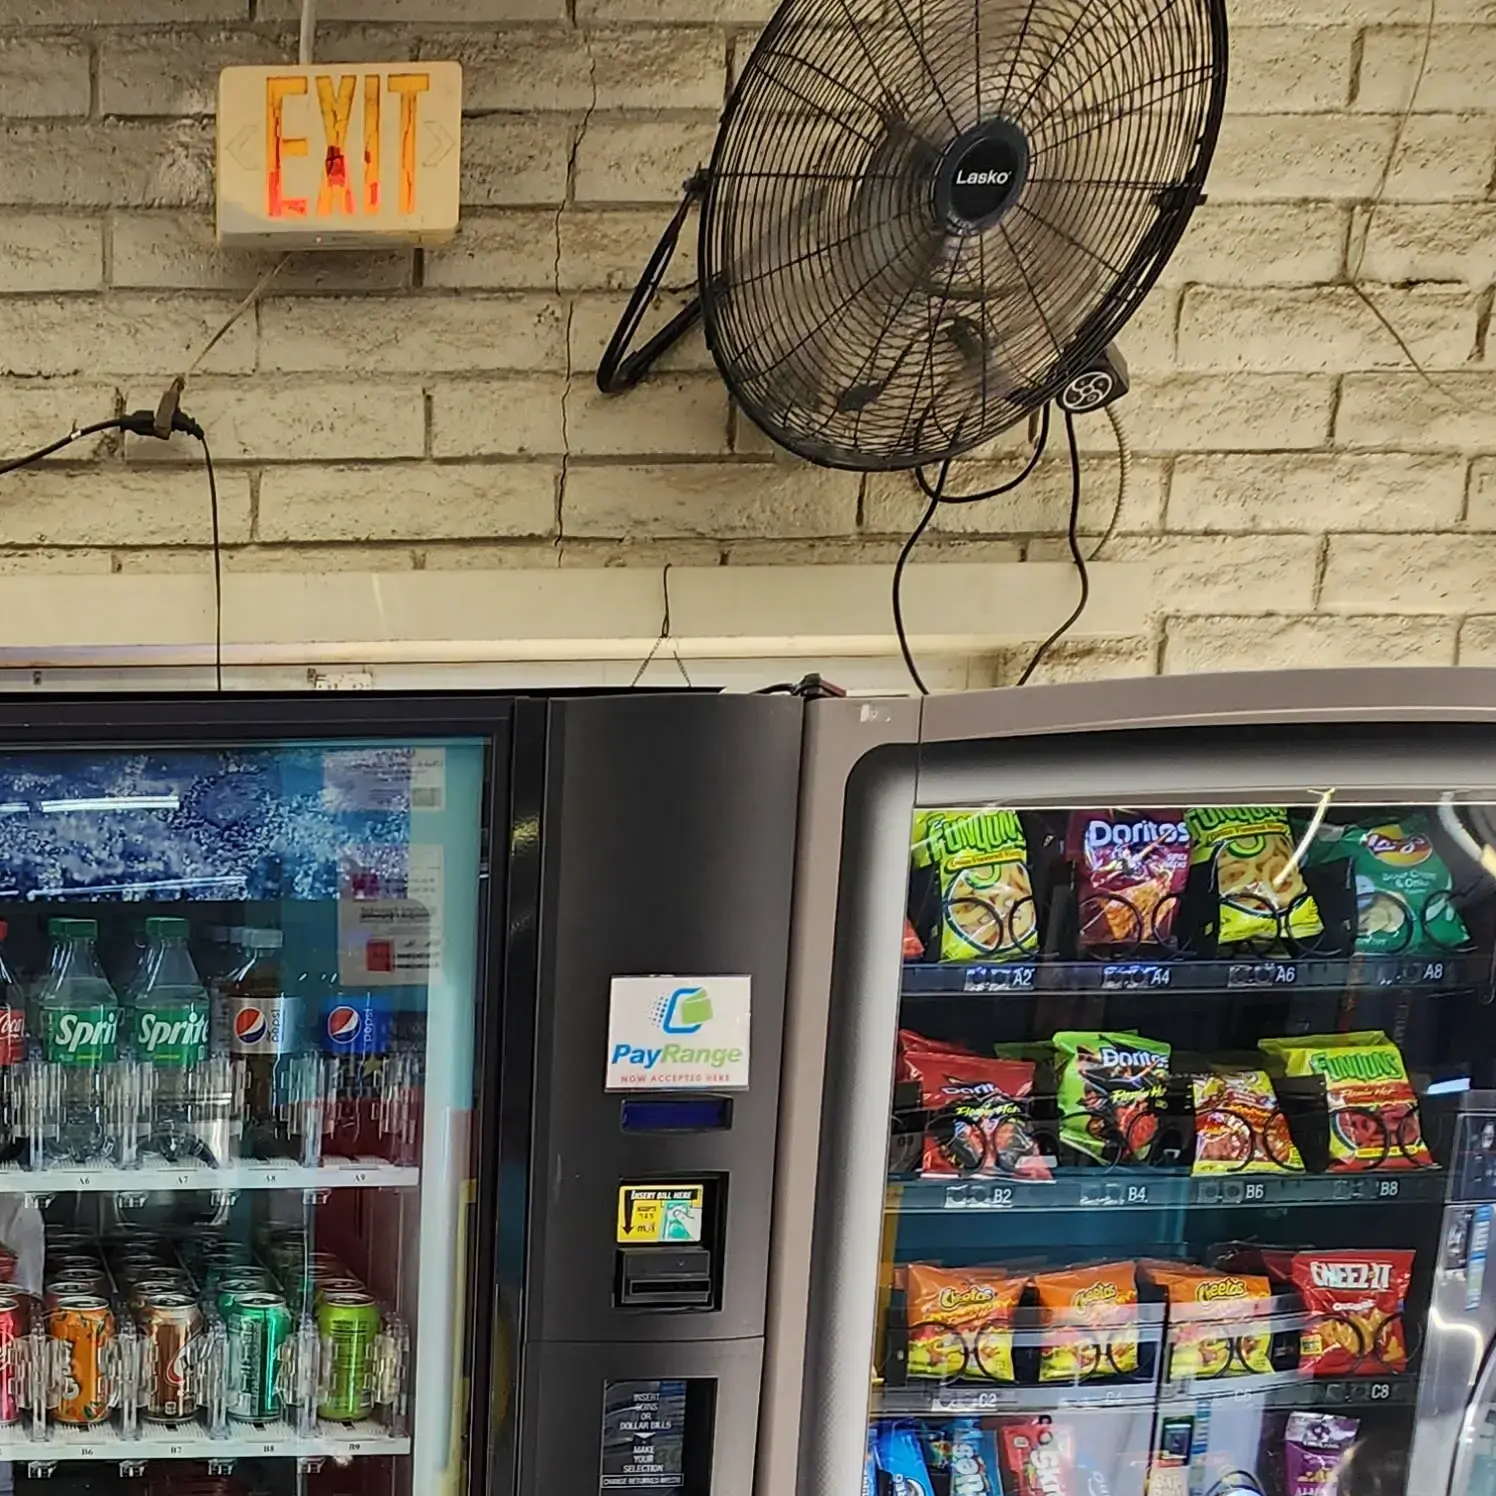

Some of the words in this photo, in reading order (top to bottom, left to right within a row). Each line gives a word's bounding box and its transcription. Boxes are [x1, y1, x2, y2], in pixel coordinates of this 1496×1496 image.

[266, 73, 429, 216] EXIT
[956, 170, 1011, 185] Lasko
[1088, 819, 1191, 846] Doritos
[1015, 970, 1032, 986] A2
[1153, 970, 1170, 984] A4
[1276, 967, 1295, 982] A6
[1424, 964, 1443, 979] A8
[270, 1008, 281, 1042] pepsi
[612, 1044, 742, 1068] PayRange
[1102, 1049, 1168, 1069] Doritos
[78, 1177, 90, 1185] A6
[176, 1176, 188, 1184] A7
[264, 1174, 276, 1182] A8
[353, 1173, 366, 1182] A9
[994, 1188, 1012, 1203] B2
[1128, 1186, 1147, 1201] B4
[1245, 1184, 1264, 1199] B6
[1380, 1181, 1398, 1196] B8
[1310, 1260, 1393, 1290] CHEEZ-IT
[939, 1285, 996, 1311] Cheetos
[1072, 1281, 1117, 1315] Cheetos
[1196, 1277, 1246, 1305] Cheetos
[1372, 1385, 1390, 1399] C8
[980, 1394, 997, 1408] C2
[620, 1422, 649, 1430] DOLLAR
[651, 1421, 671, 1429] BILLS
[81, 1447, 94, 1456] B6
[170, 1446, 182, 1454] B7
[263, 1445, 275, 1453] B8
[349, 1443, 361, 1451] B9
[633, 1446, 655, 1454] MAKE
[633, 1455, 654, 1463] YOUR
